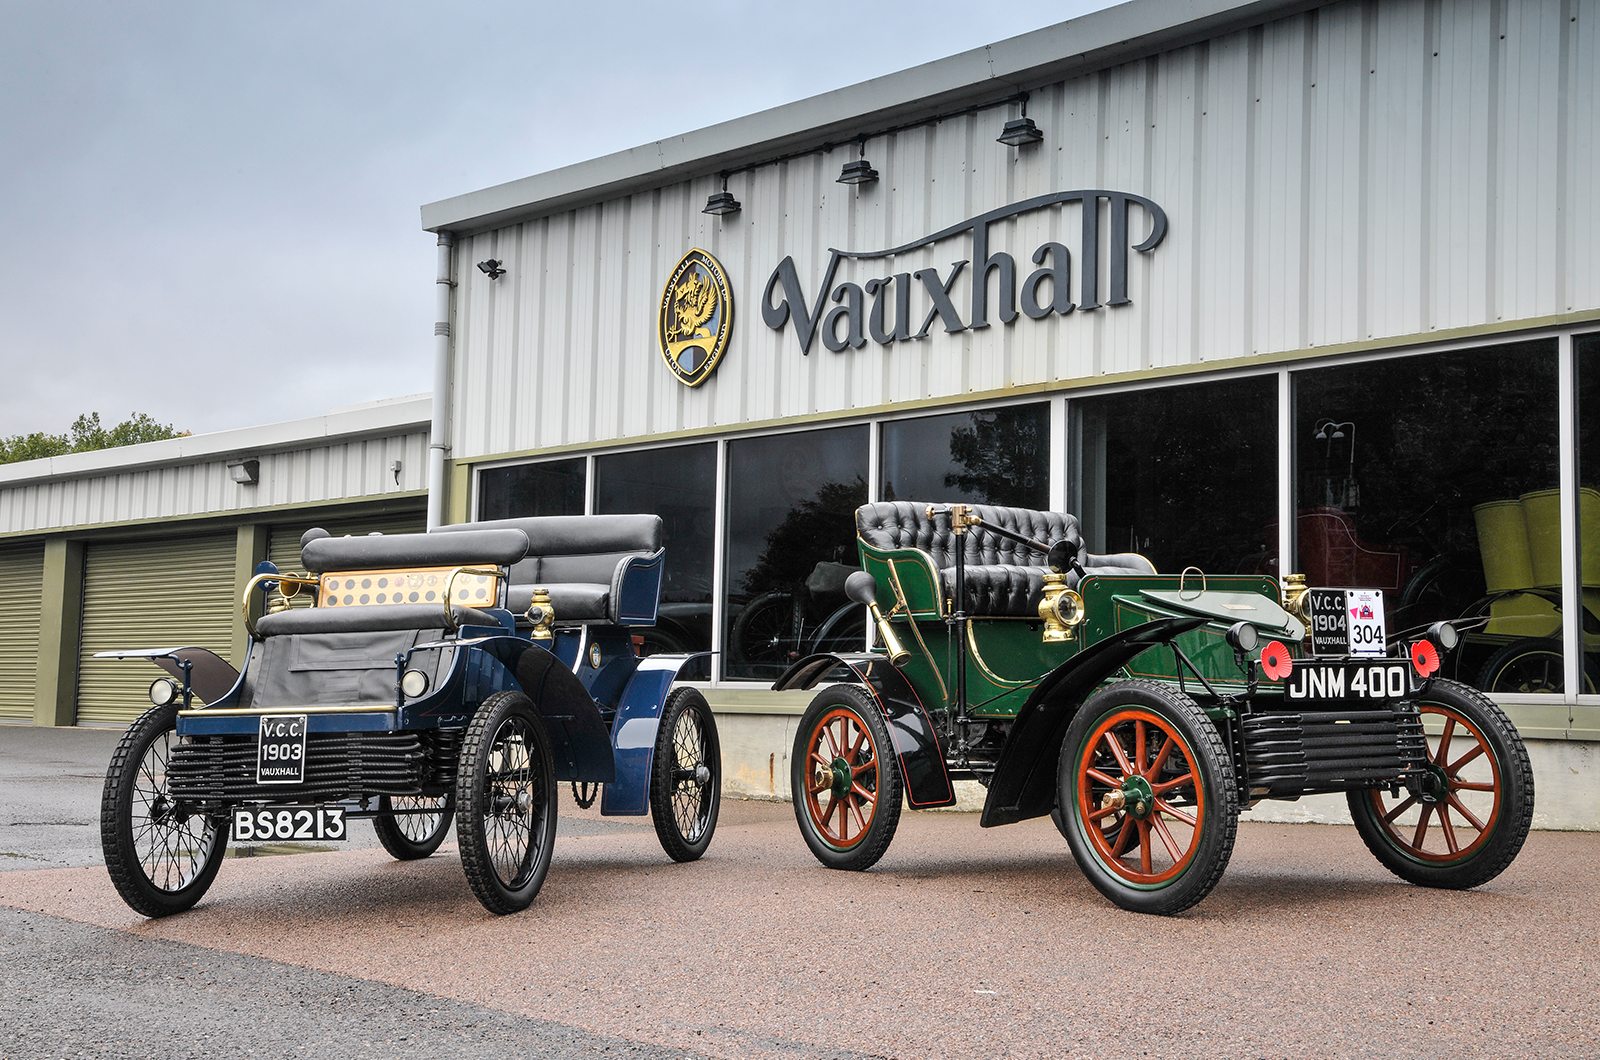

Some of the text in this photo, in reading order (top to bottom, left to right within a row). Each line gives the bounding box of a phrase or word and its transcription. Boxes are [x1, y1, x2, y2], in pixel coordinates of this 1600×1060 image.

[663, 260, 691, 308] VAUXHALL
[701, 255, 723, 286] MOTORS
[761, 189, 1168, 356] Vauxhall
[703, 323, 726, 371] ENGLAND
[1312, 596, 1345, 610] V.C.C.
[1313, 615, 1347, 632] 1904
[1315, 636, 1347, 645] VAUXHALL
[1353, 624, 1384, 644] 304
[1290, 666, 1405, 698] JNM 400
[263, 723, 302, 738] V.C.C.
[262, 743, 302, 760] 1903
[261, 767, 299, 776] VAUXHALL
[235, 810, 345, 840] BS8213
